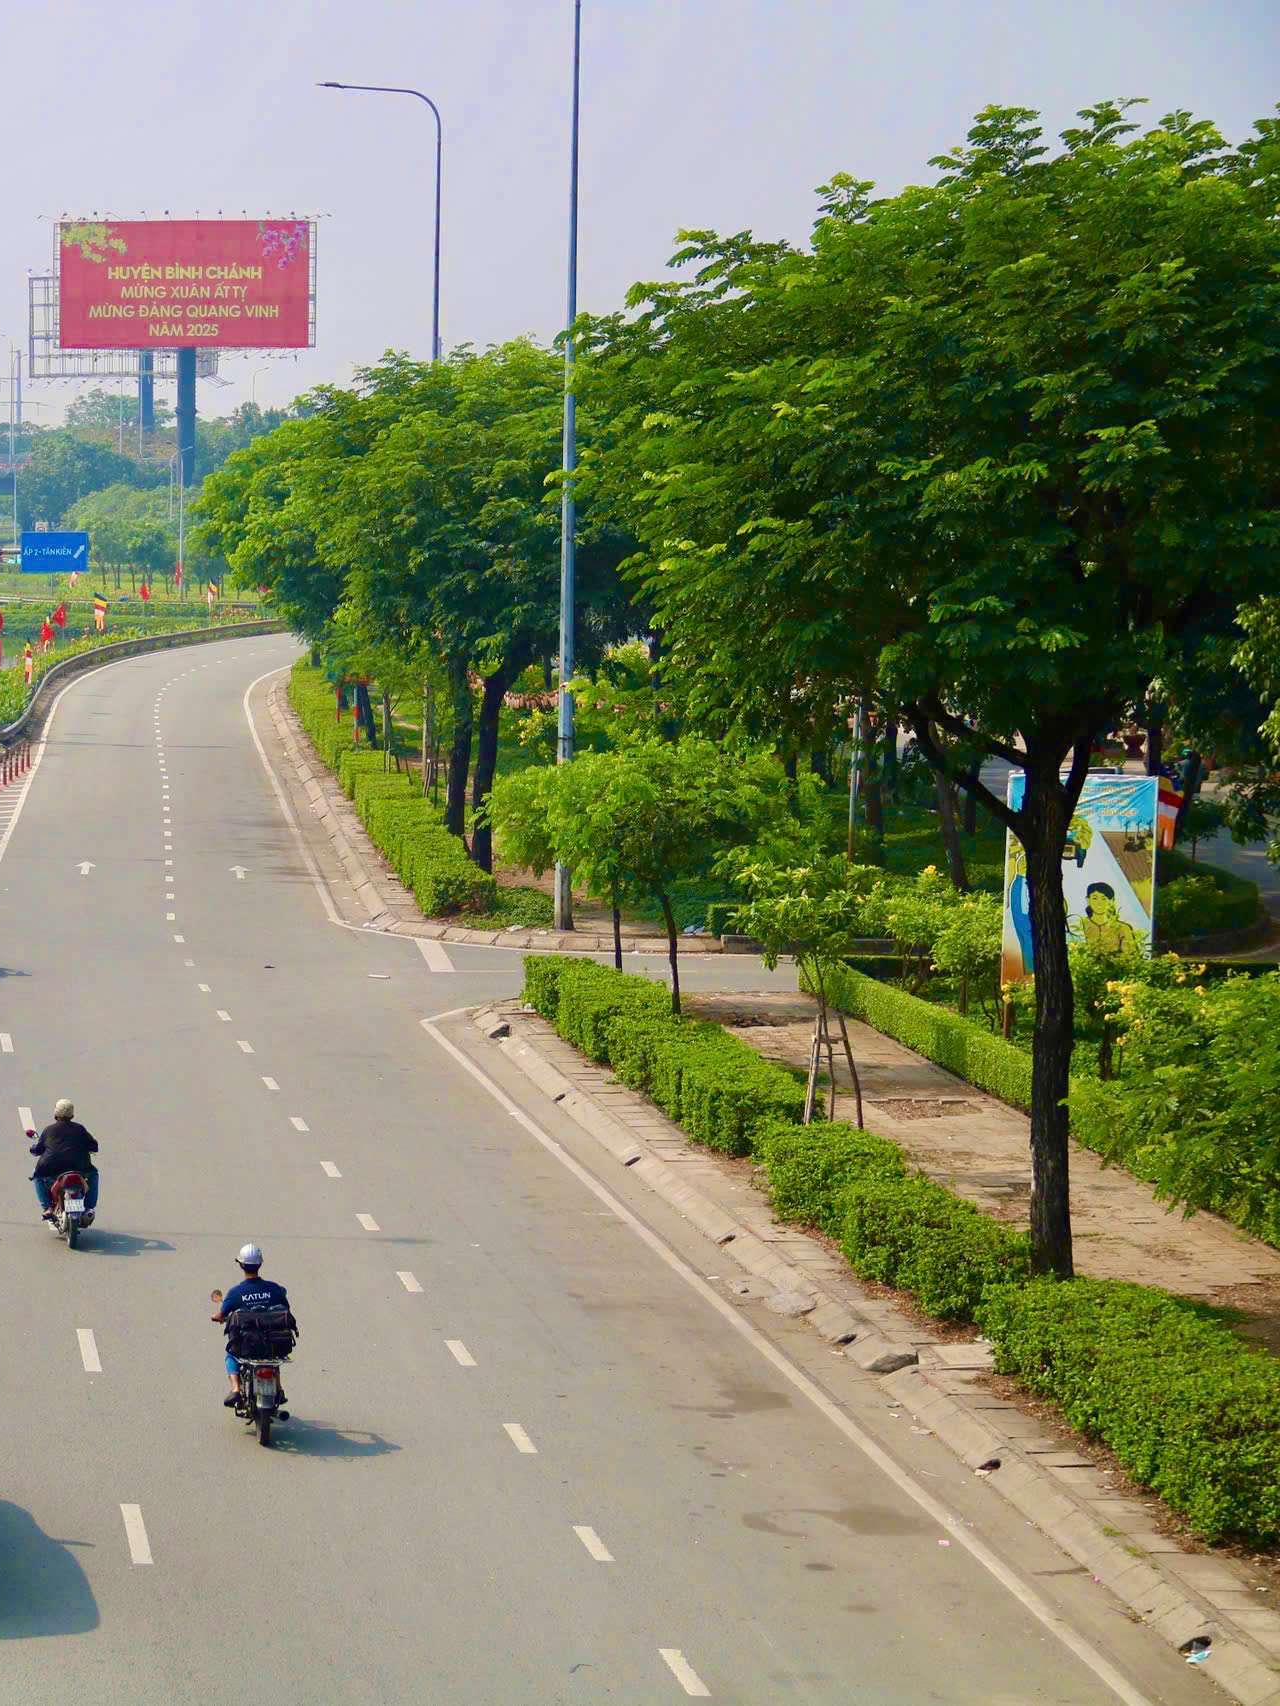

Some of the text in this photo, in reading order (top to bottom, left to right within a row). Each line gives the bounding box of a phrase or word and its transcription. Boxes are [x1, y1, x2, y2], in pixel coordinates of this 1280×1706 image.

[107, 262, 263, 283] HUYỆN BÌNH CHÁNH
[121, 282, 248, 302] MỪNG XUÂN ẤT TỴ
[89, 301, 279, 318] MỪNG ĐẢNG QUANG VINH
[149, 321, 219, 337] NĂM 2025
[241, 1292, 271, 1302] KATUN
